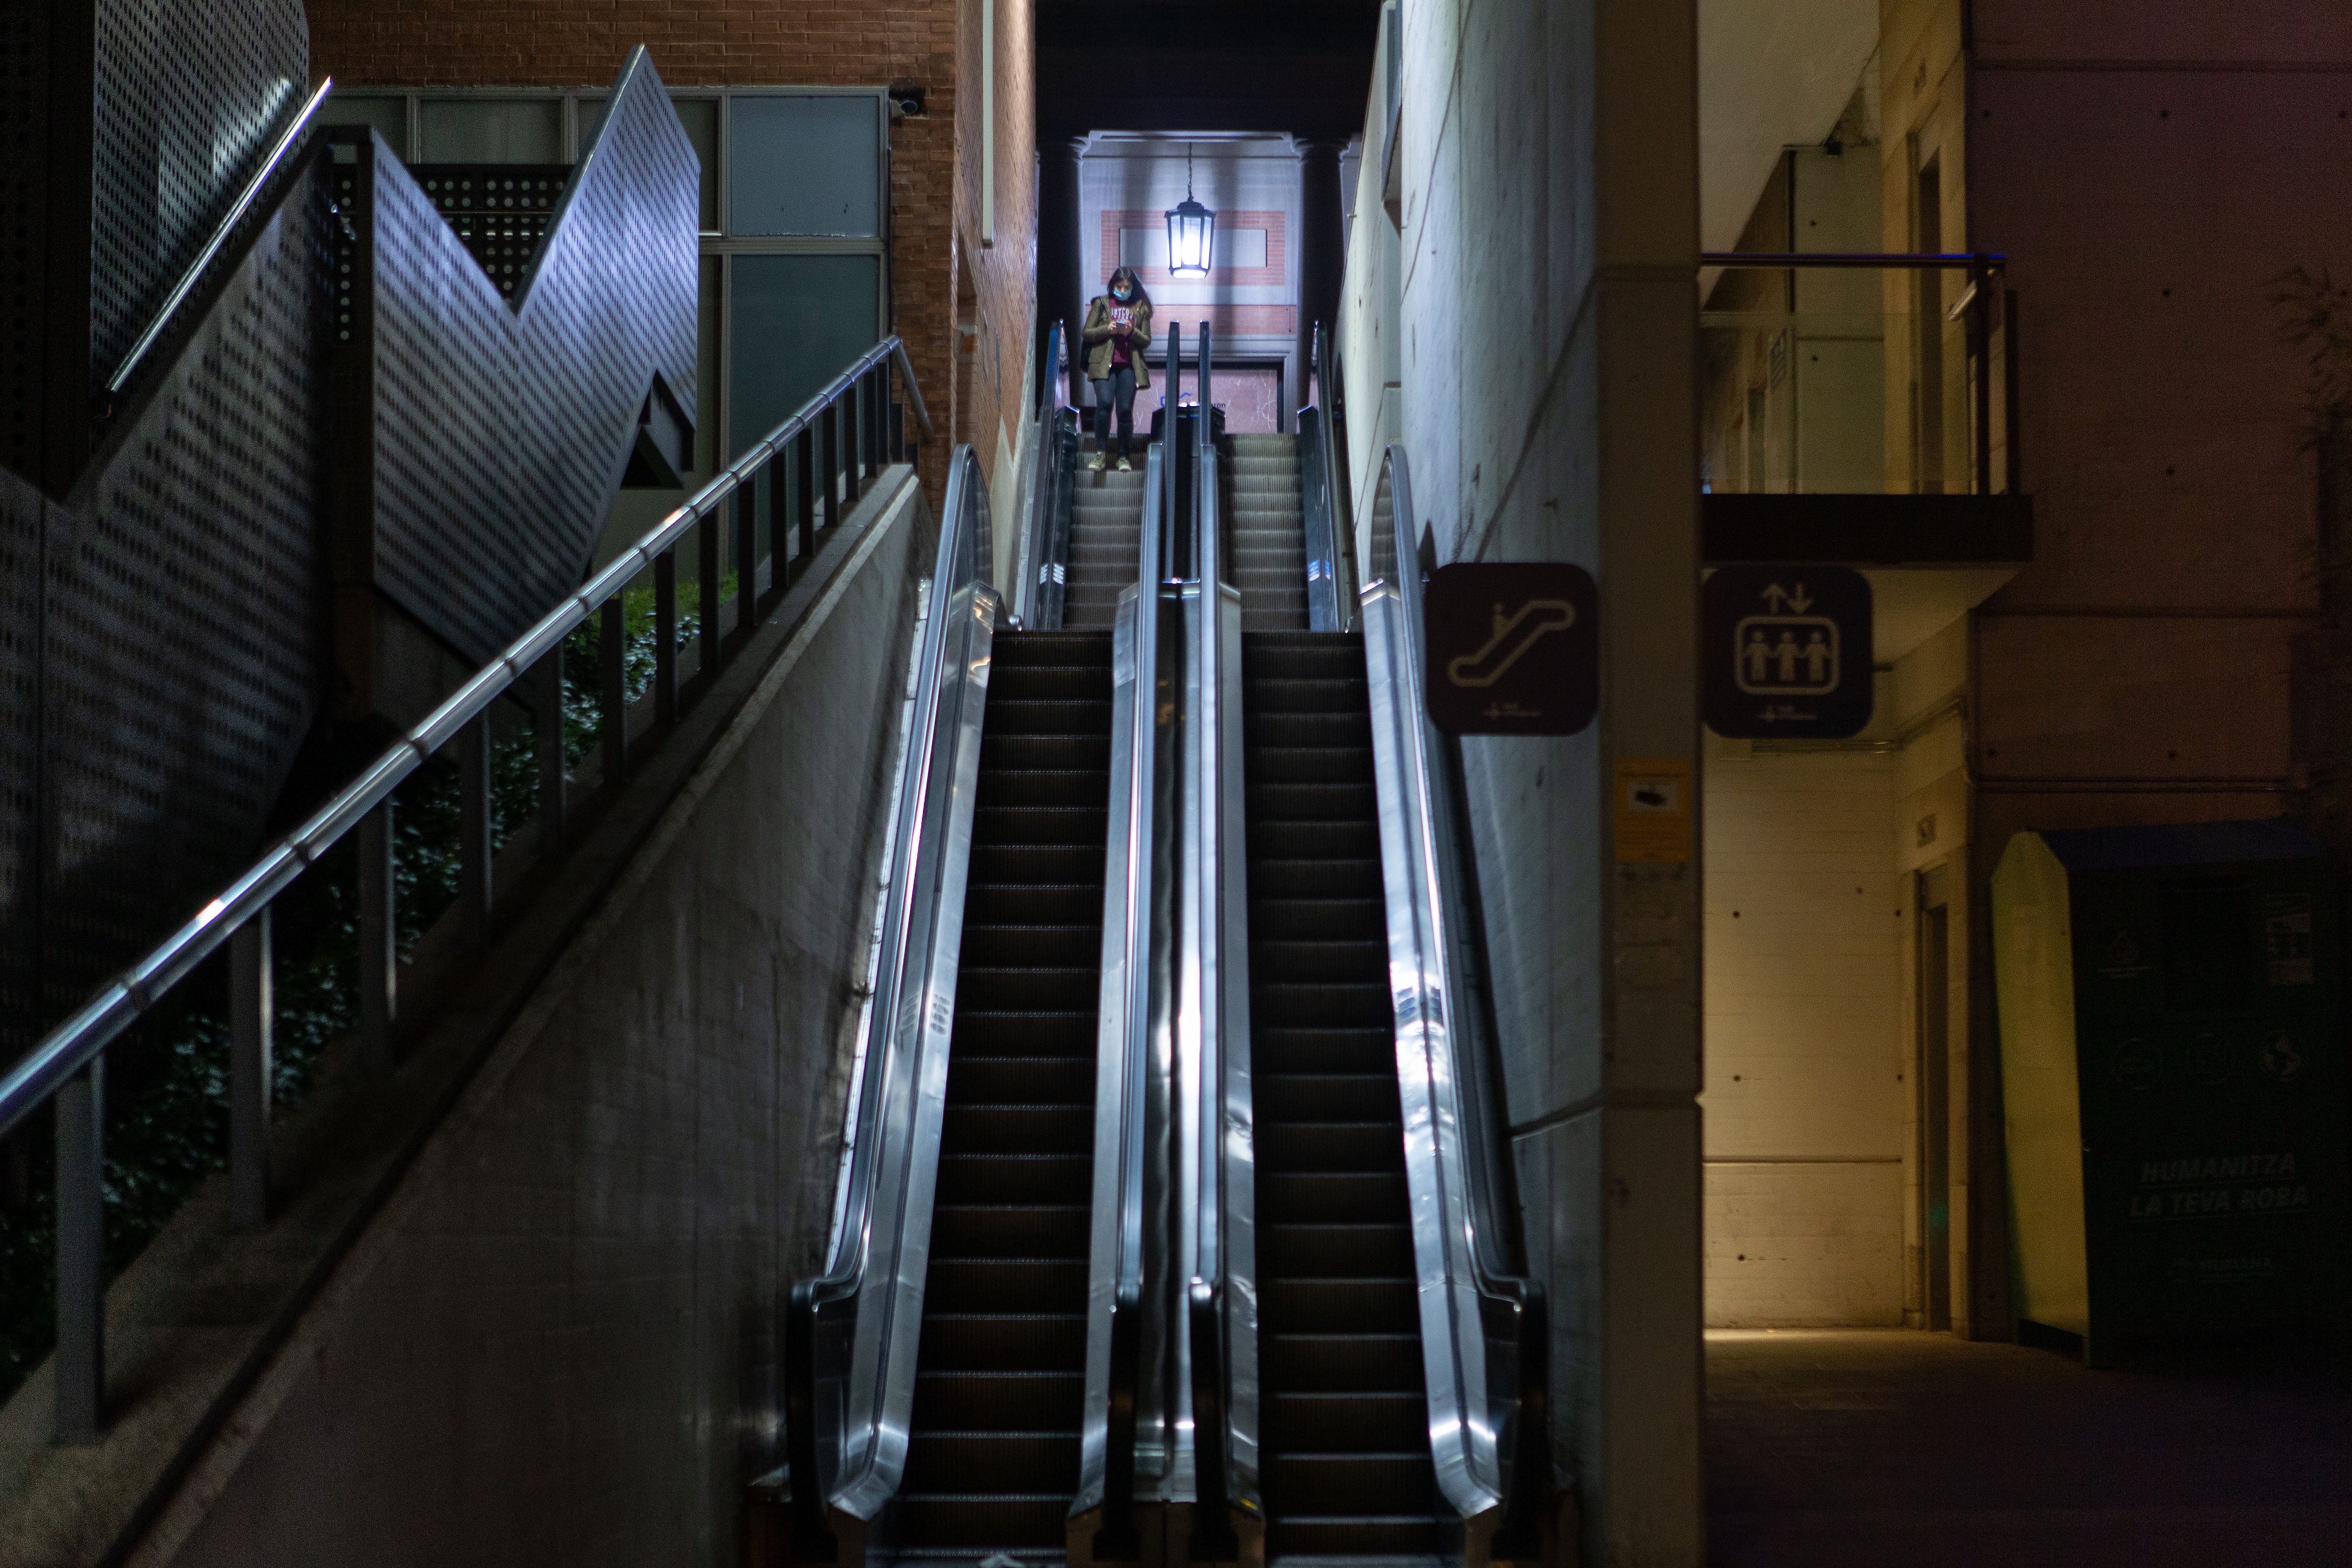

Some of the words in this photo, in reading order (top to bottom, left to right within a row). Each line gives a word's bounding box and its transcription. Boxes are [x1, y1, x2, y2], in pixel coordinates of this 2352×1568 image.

[2141, 1152, 2296, 1182] HUMANITZA
[2129, 1194, 2161, 1217] LA
[2170, 1190, 2230, 1214] TEVA
[2240, 1185, 2310, 1210] ROBA
